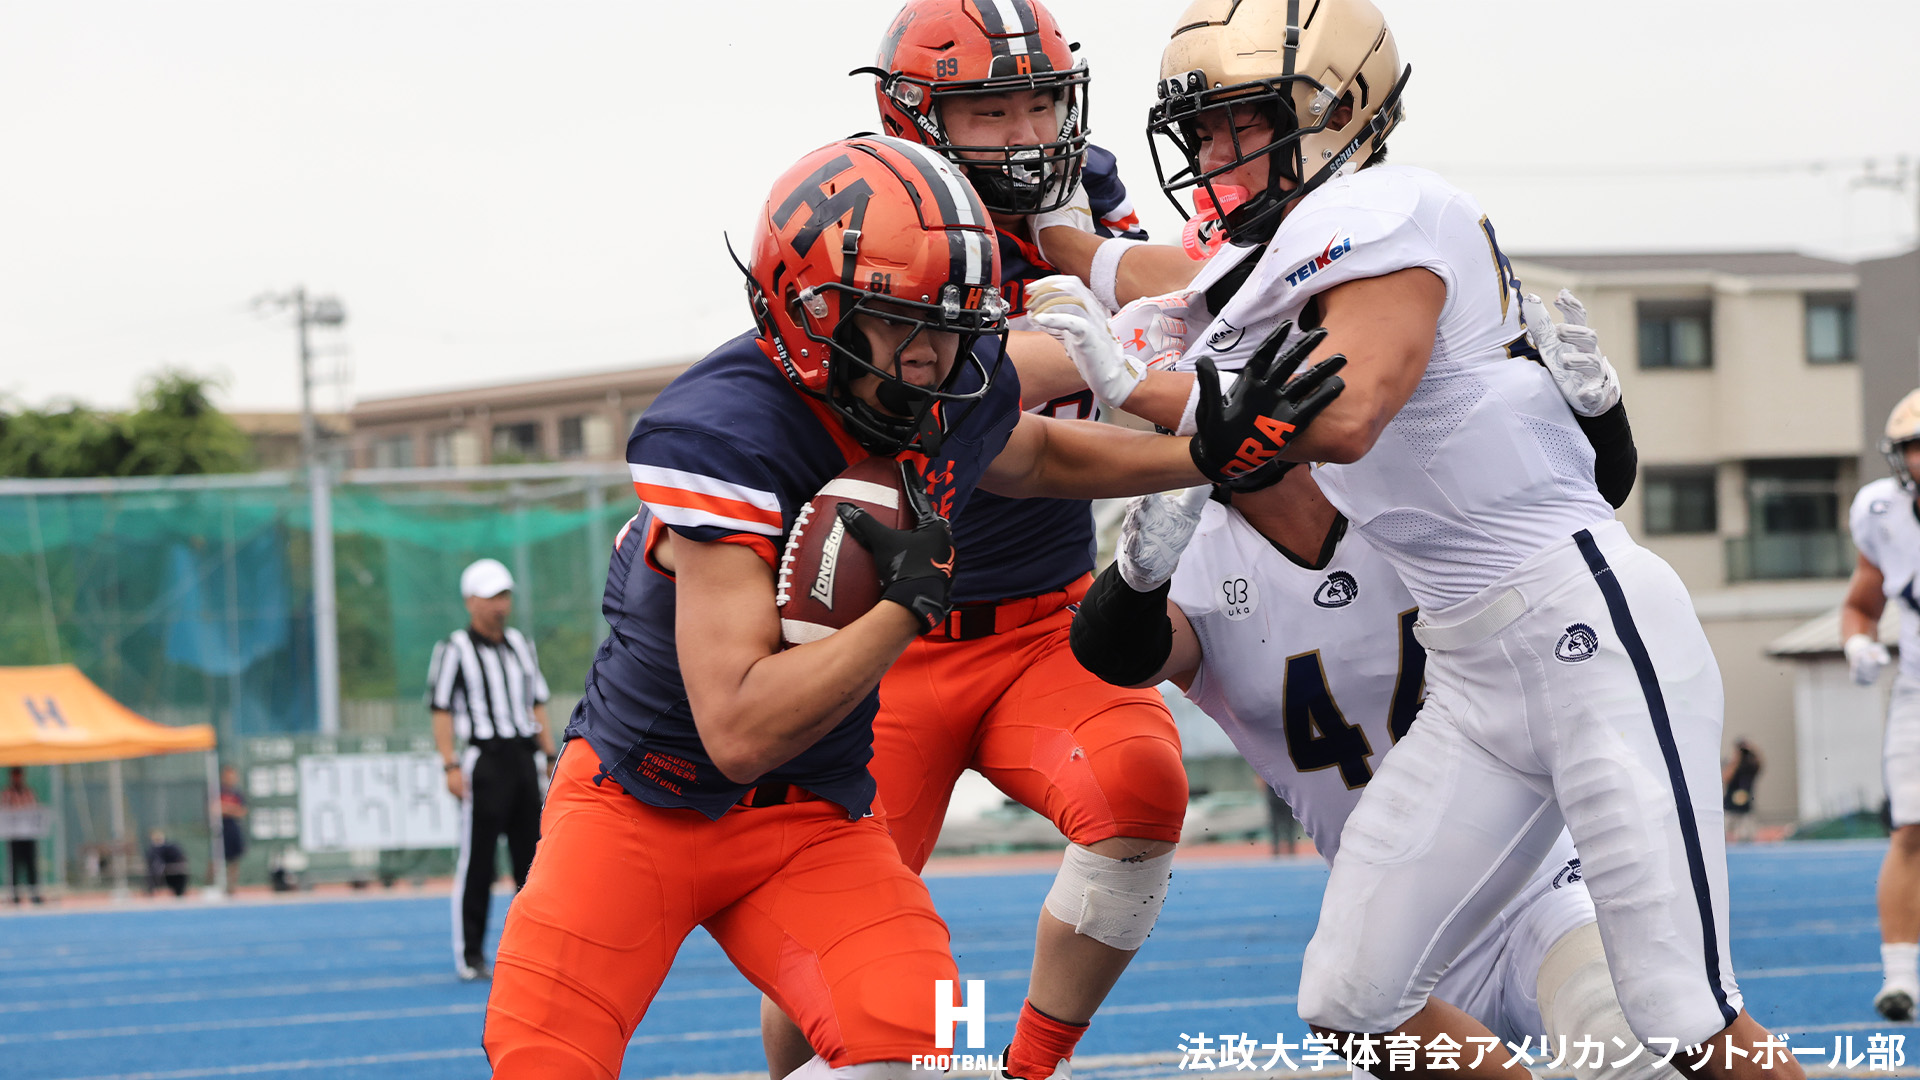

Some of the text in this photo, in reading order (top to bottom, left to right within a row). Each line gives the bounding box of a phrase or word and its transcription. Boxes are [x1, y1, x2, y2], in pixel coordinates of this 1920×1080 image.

[936, 58, 958, 78] 89
[1016, 55, 1032, 75] H
[772, 154, 875, 259] H
[870, 272, 891, 294] 81
[964, 288, 983, 309] H
[1228, 606, 1250, 617] uka
